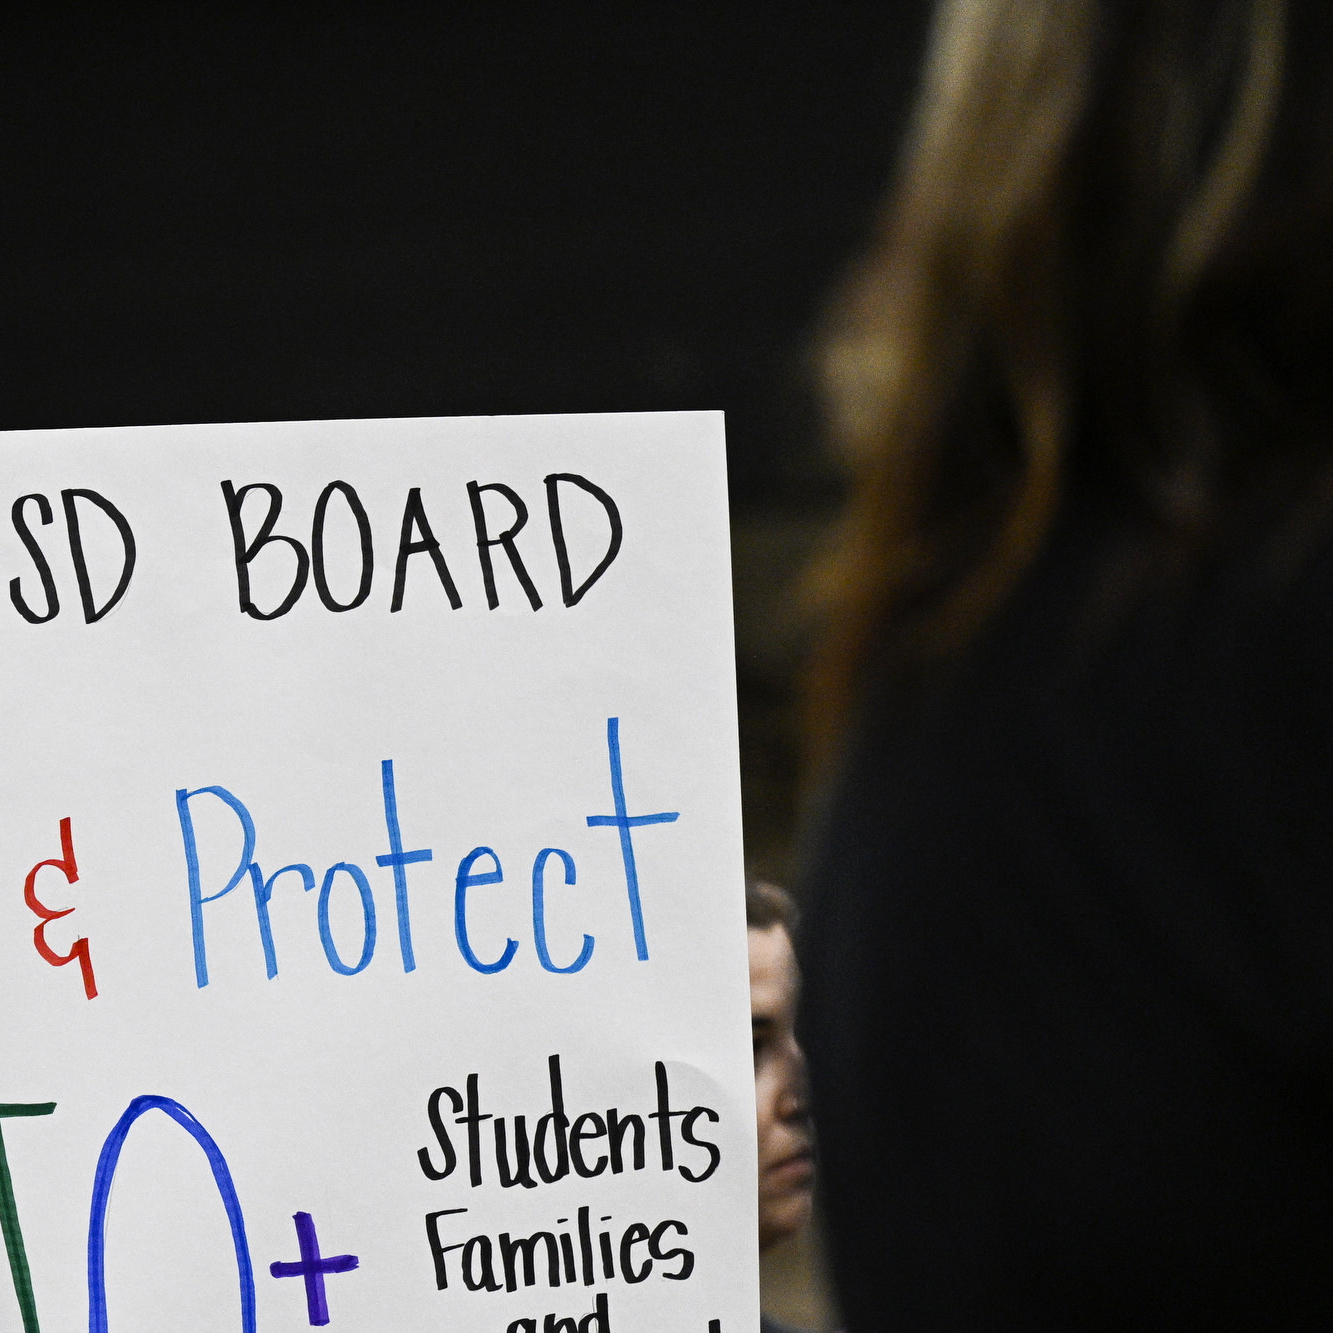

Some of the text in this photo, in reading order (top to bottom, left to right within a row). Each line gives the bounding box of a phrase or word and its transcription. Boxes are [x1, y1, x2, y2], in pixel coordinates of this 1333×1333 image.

[221, 473, 622, 620] BOARD
[24, 817, 98, 1000] &
[175, 717, 680, 989] Protect
[417, 1054, 722, 1189] Students
[425, 1206, 695, 1293] Families
